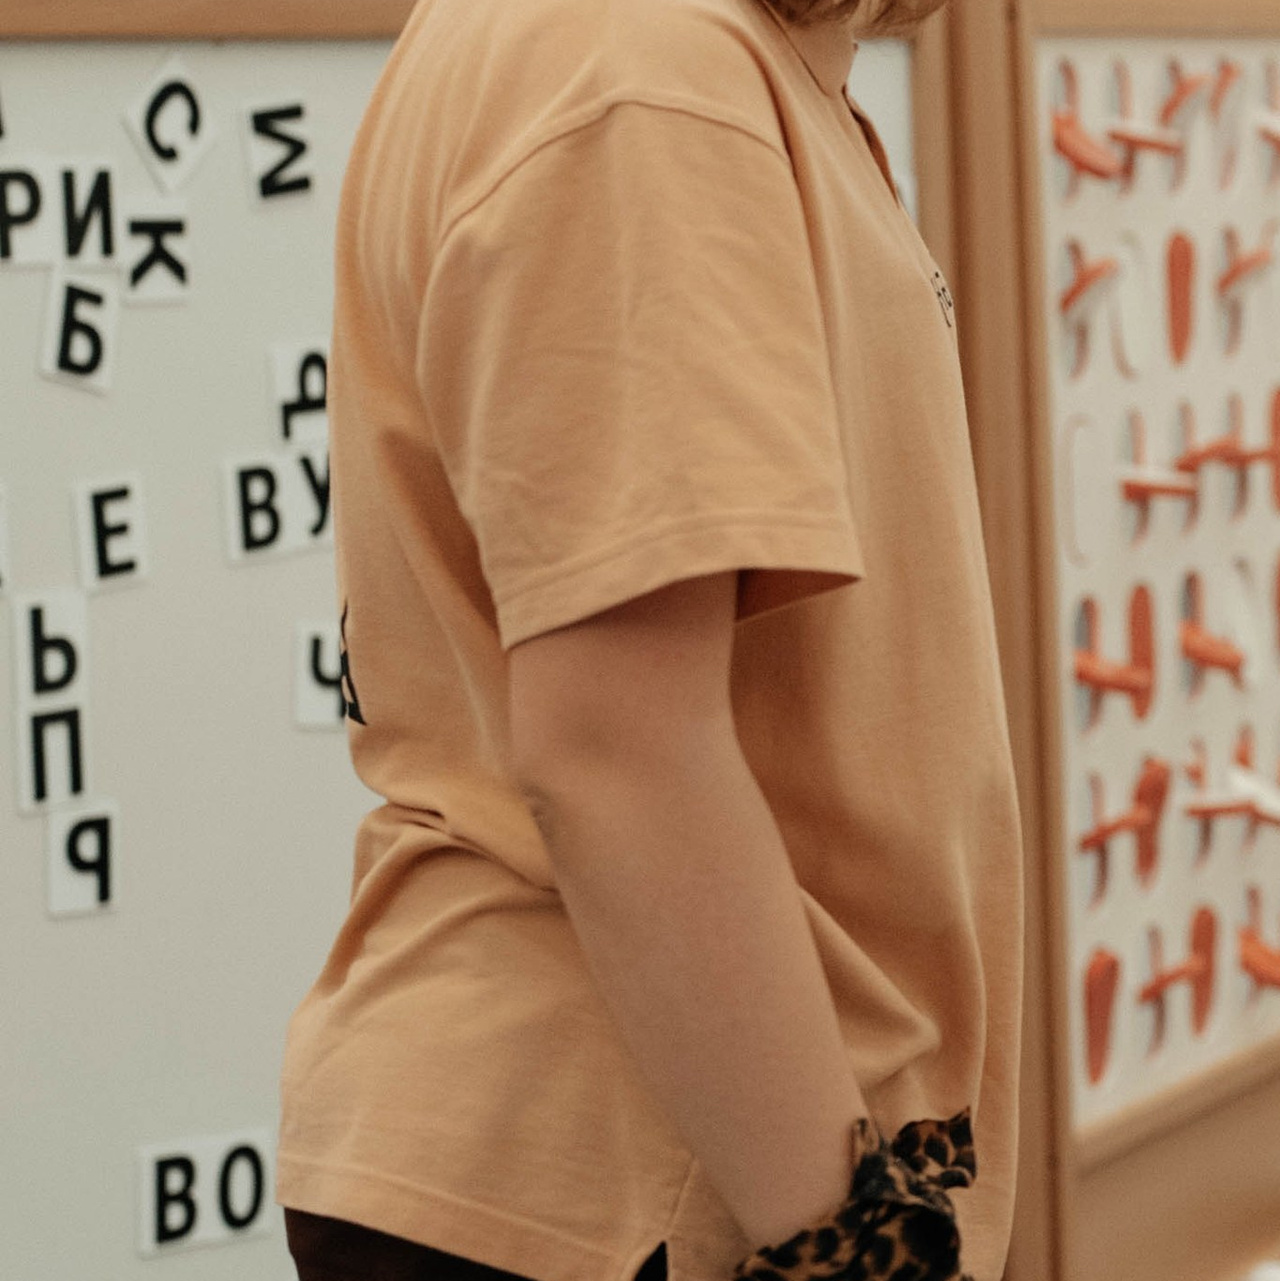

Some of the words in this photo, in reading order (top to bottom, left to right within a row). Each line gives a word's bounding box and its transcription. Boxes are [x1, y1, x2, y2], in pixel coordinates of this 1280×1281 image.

[144, 79, 201, 162] С
[128, 220, 187, 288] К
[56, 283, 104, 377] Б
[91, 486, 137, 579] Е
[30, 708, 83, 803] П
[155, 1144, 265, 1246] ВО
